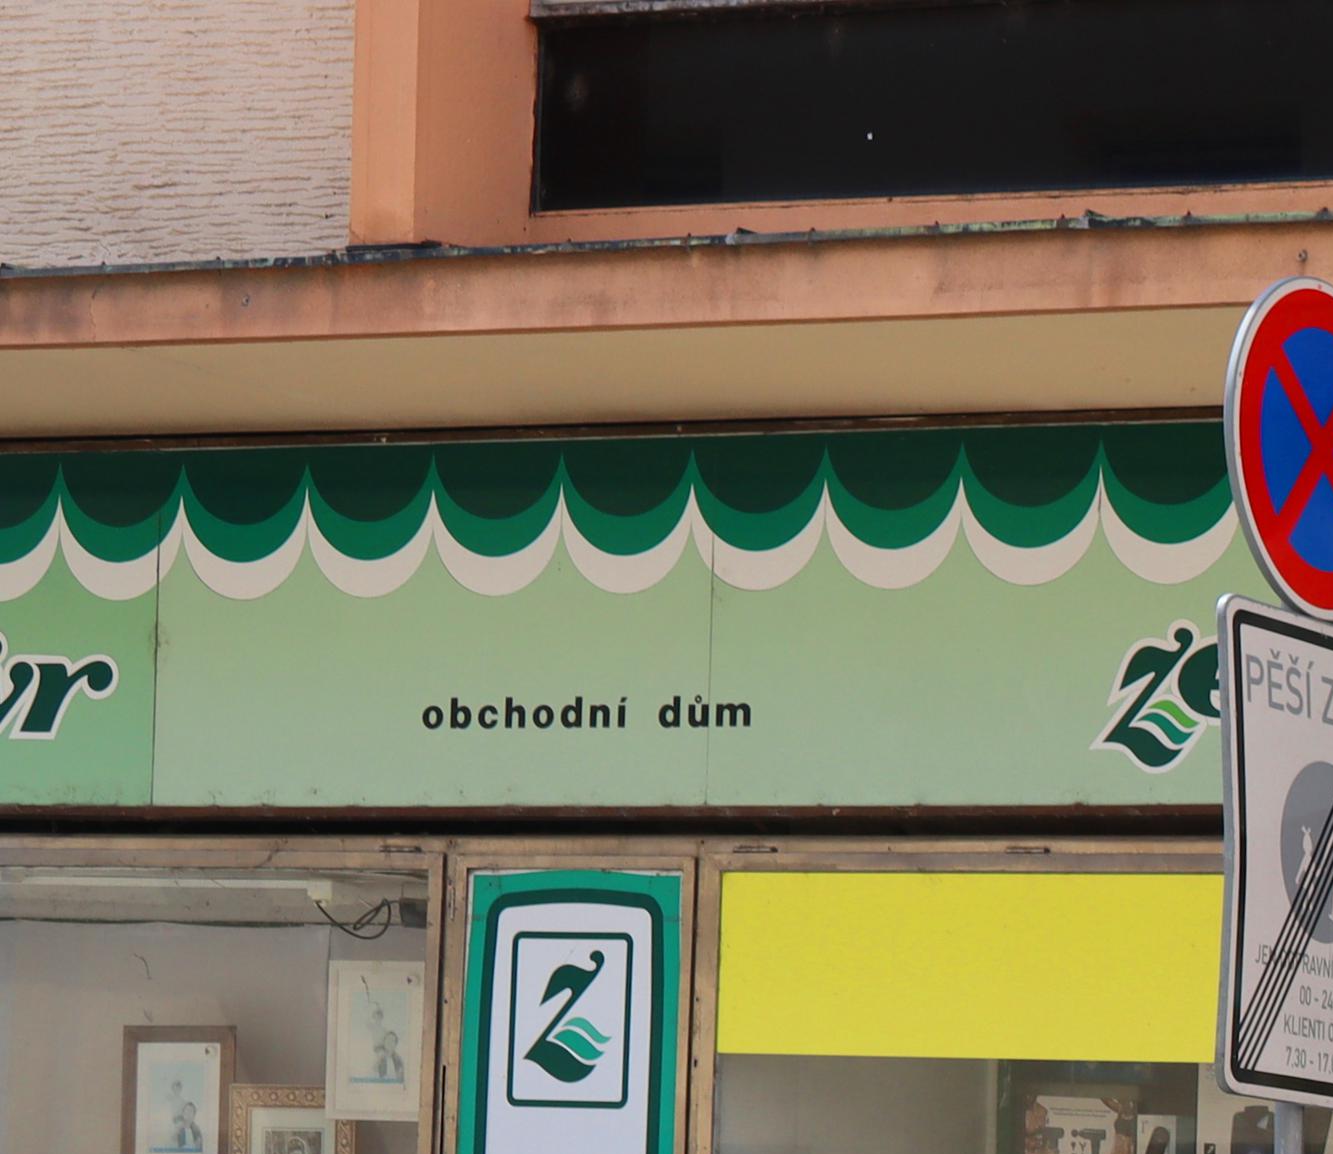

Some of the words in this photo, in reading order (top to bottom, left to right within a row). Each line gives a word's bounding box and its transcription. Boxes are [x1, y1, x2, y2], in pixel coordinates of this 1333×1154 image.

[1245, 648, 1314, 719] PĚŠÍ
[423, 697, 628, 729] obchodní
[659, 695, 752, 727] dům
[1299, 985, 1312, 1006] 00
[1321, 989, 1333, 1010] 24
[1283, 1013, 1326, 1041] KLIENTI
